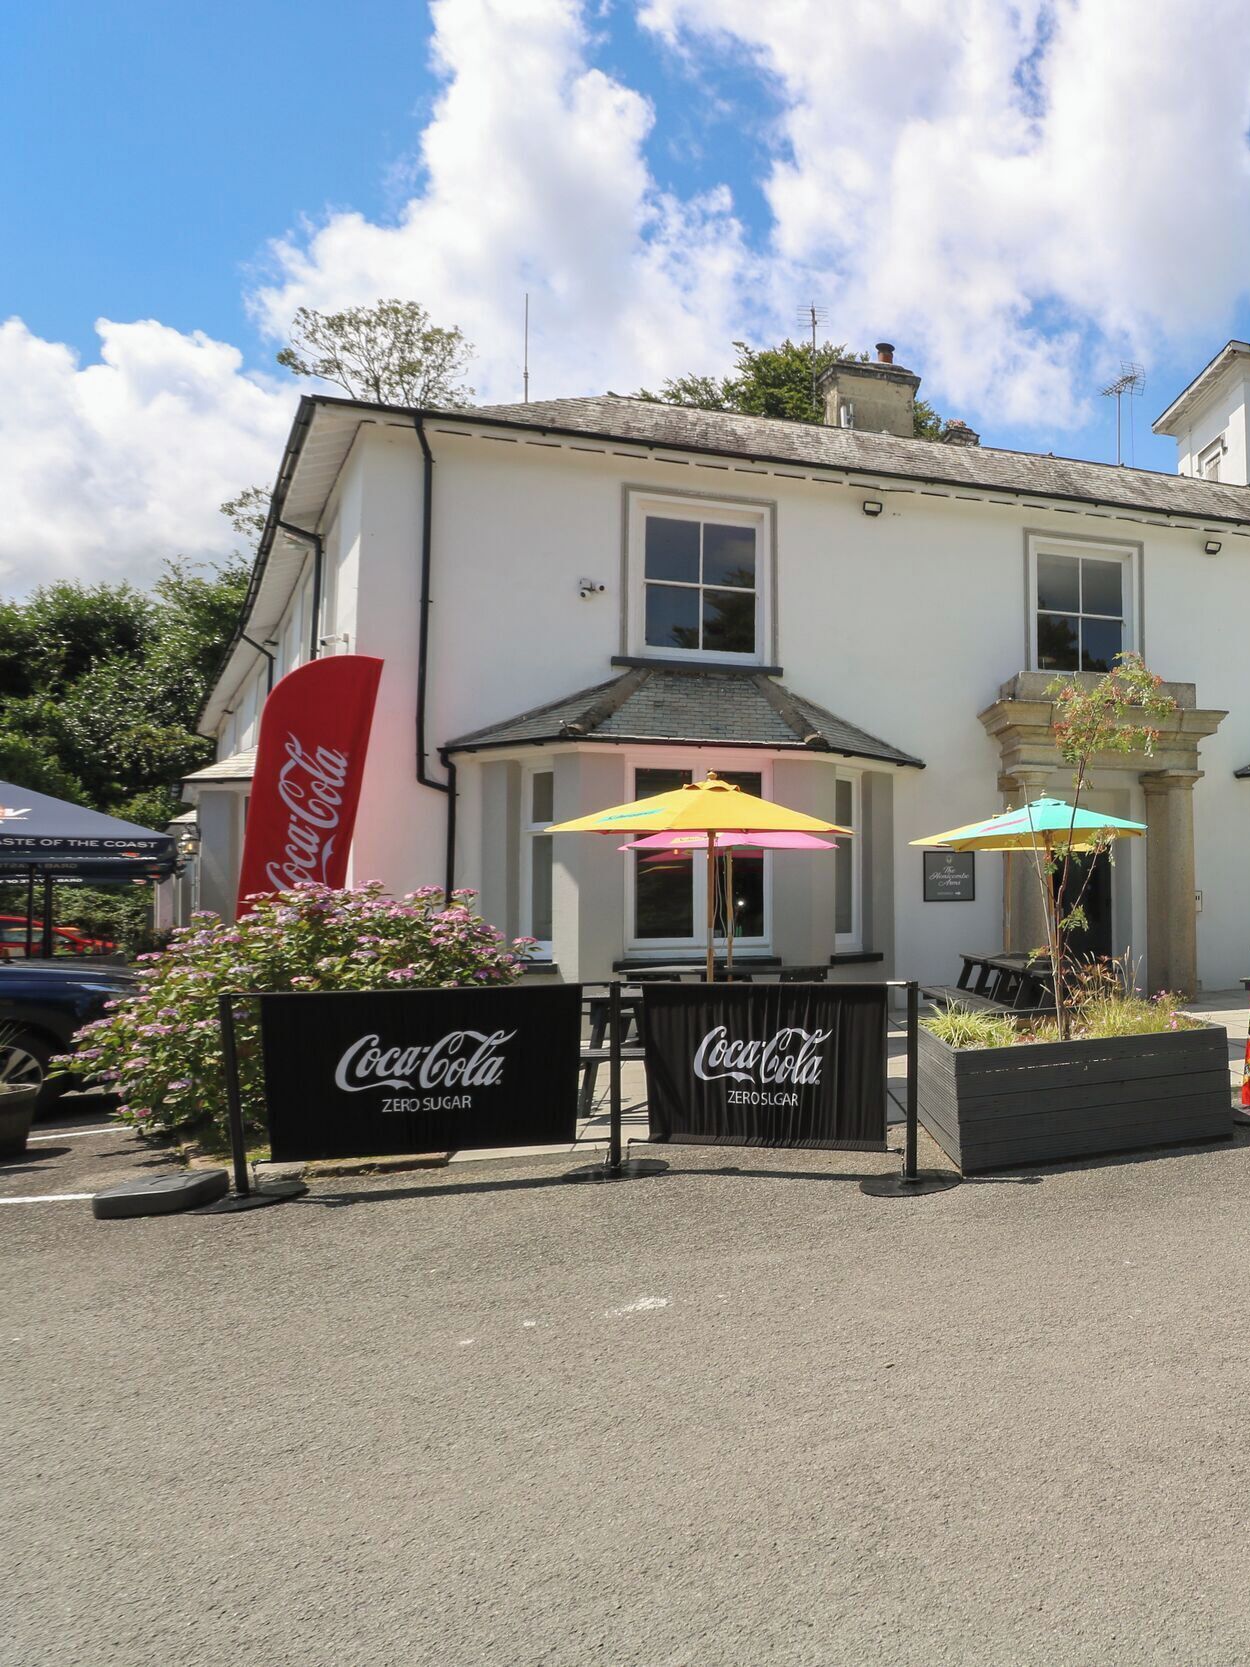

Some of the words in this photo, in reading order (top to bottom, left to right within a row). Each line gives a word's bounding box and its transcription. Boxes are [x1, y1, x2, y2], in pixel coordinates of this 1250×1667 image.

[0, 838, 35, 846] STE
[40, 839, 64, 847] OF
[68, 839, 99, 847] THE
[104, 840, 158, 848] COAST
[335, 1029, 517, 1092] Coca-Cola
[693, 1025, 833, 1085] Coca-Cola
[382, 1098, 421, 1112] ZERO
[423, 1095, 472, 1110] SUGAR
[727, 1090, 760, 1104] ZERO
